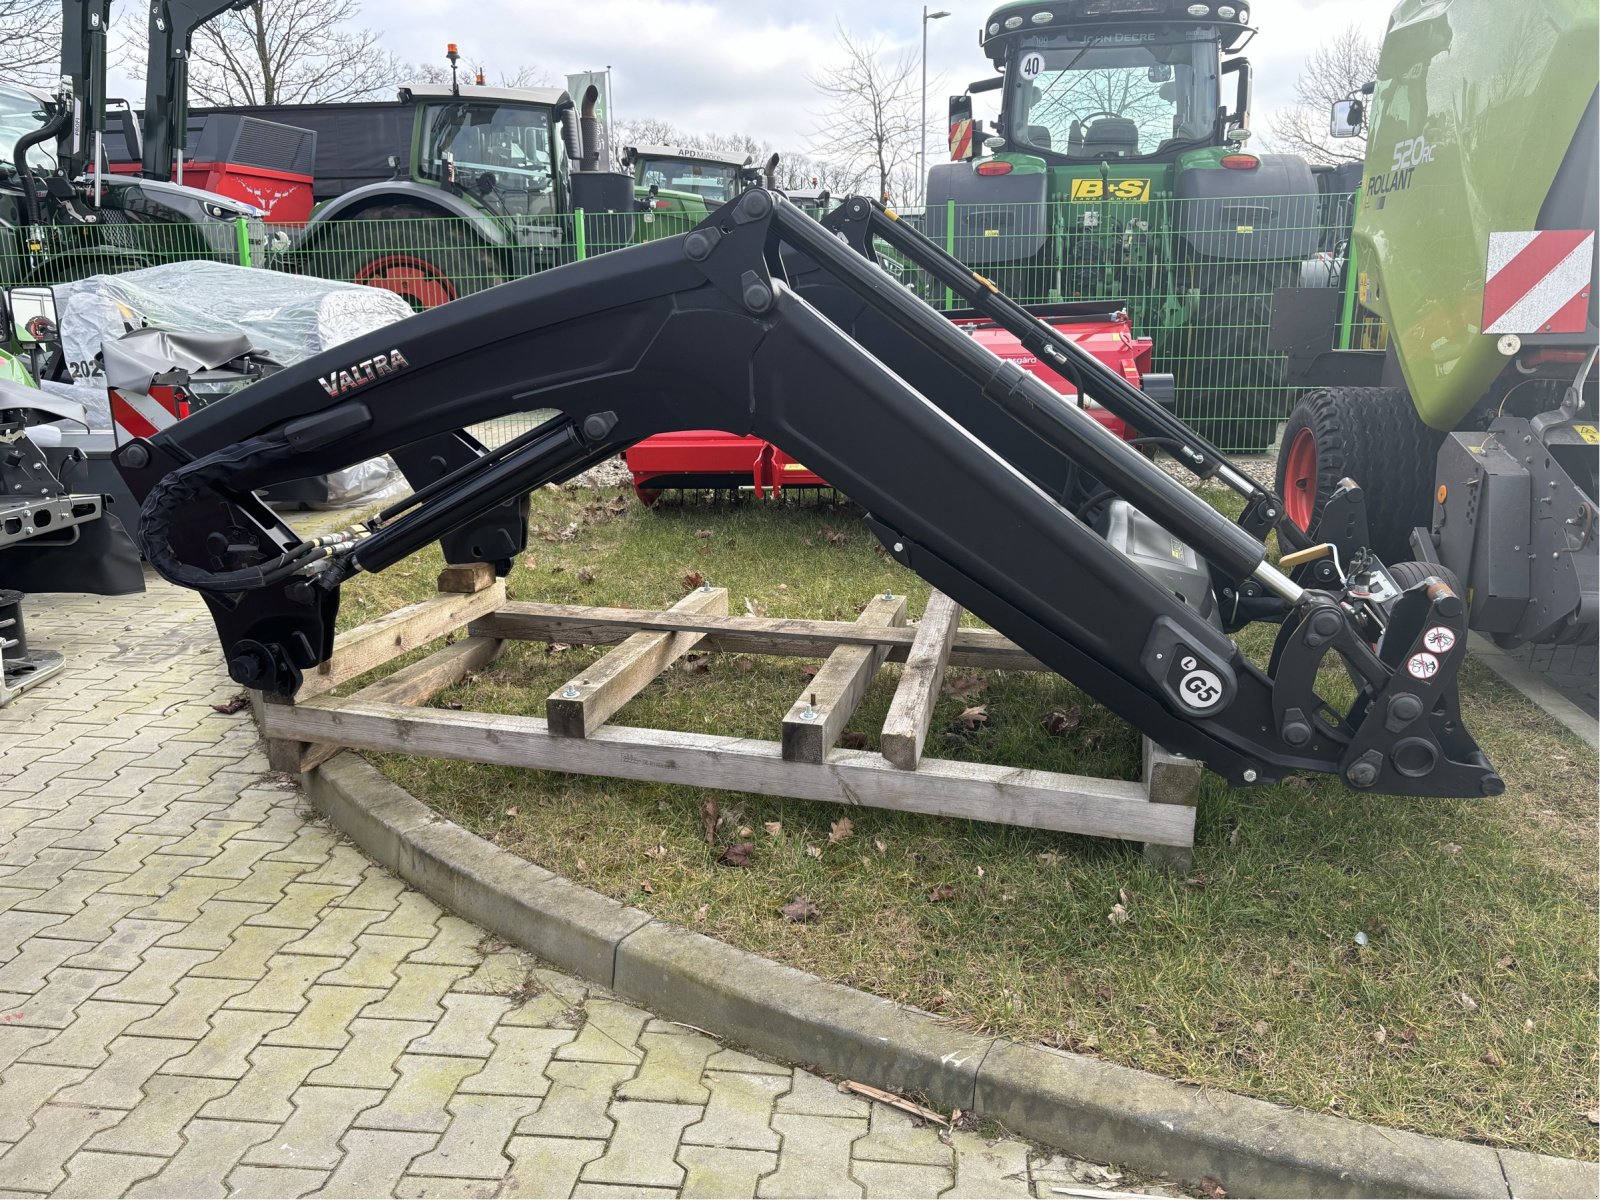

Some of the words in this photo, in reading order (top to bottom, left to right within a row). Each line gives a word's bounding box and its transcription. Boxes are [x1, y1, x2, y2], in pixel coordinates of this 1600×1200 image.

[1024, 57, 1040, 75] 40
[678, 149, 697, 158] APD
[1074, 180, 1144, 199] B+S
[1367, 167, 1416, 196] ROLLANT
[318, 349, 409, 398] VALTRA
[1185, 676, 1220, 702] G5
